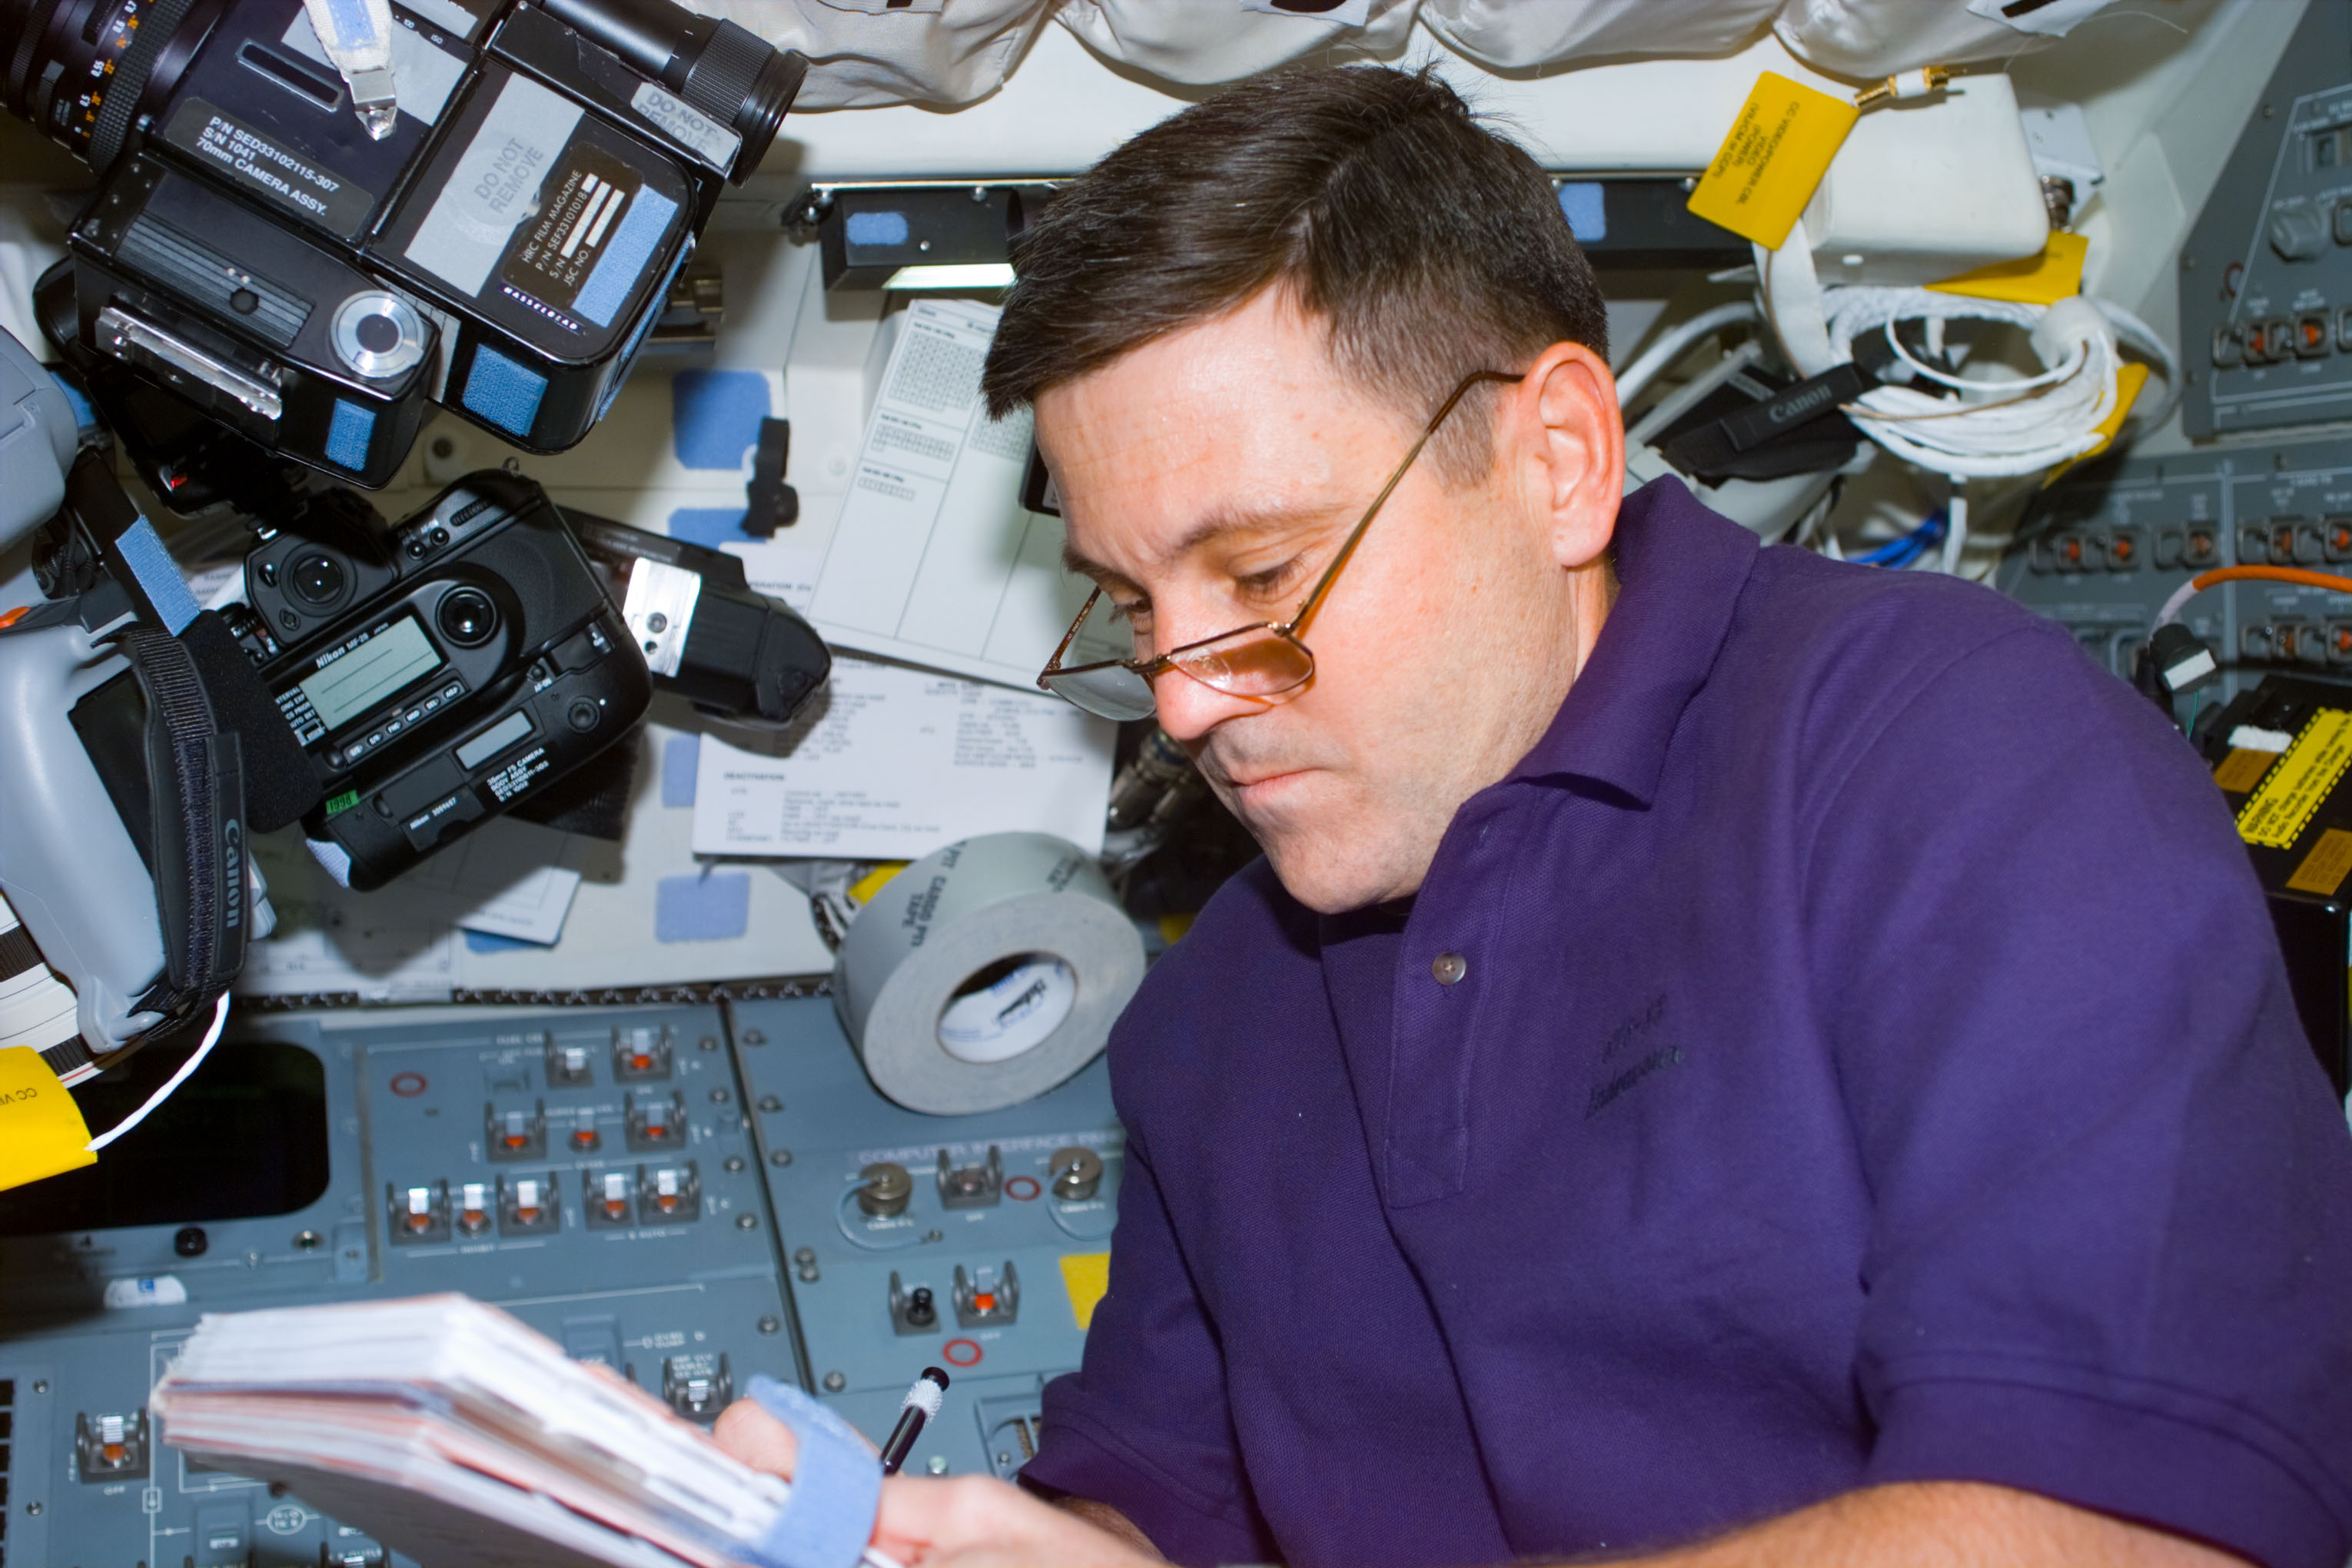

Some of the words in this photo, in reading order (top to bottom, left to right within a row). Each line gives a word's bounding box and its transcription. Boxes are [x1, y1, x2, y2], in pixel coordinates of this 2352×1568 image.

[646, 91, 676, 114] DO
[677, 108, 718, 137] NOT
[202, 126, 228, 146] S/N
[227, 140, 257, 161] 1041
[208, 115, 234, 135] P/N
[232, 128, 340, 193] SED33102115-307
[195, 136, 234, 164] 70mm
[234, 158, 291, 195] CAMERA
[289, 189, 327, 217] ASSY.
[473, 171, 500, 201] DO
[492, 137, 525, 170] NOT
[488, 146, 544, 214] REMOVE
[522, 240, 540, 264] HRC
[534, 220, 553, 244] FILM
[548, 169, 583, 221] MAGAZINE
[535, 249, 554, 272] P/N
[549, 257, 567, 280] S/N
[563, 267, 580, 287] JSC
[1769, 384, 1833, 424] Canon
[315, 645, 346, 669] Nikon
[274, 686, 302, 706] NTERVAL
[224, 818, 241, 929] Canon
[15, 1087, 38, 1101] CC
